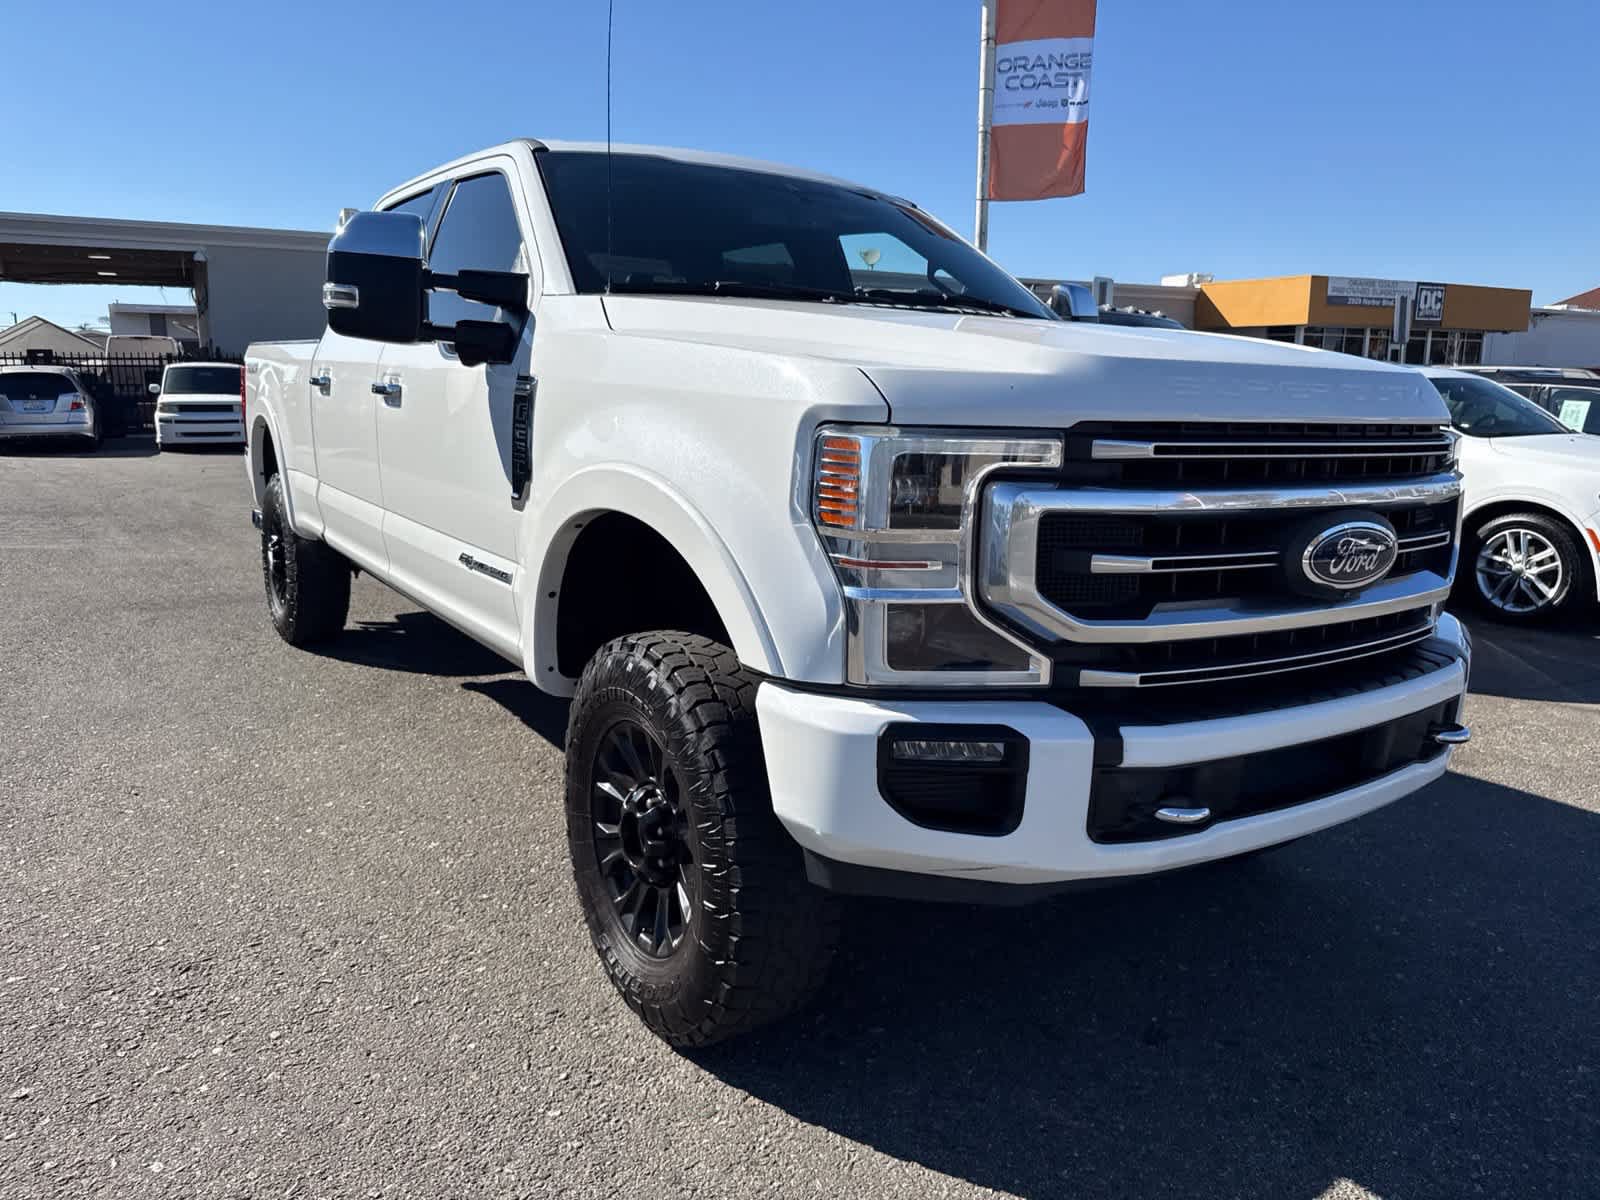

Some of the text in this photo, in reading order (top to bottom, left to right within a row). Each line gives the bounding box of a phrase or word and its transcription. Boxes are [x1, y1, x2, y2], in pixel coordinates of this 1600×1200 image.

[997, 53, 1092, 73] ORANGE
[1005, 72, 1082, 90] COAST
[1330, 536, 1386, 574] Ford
